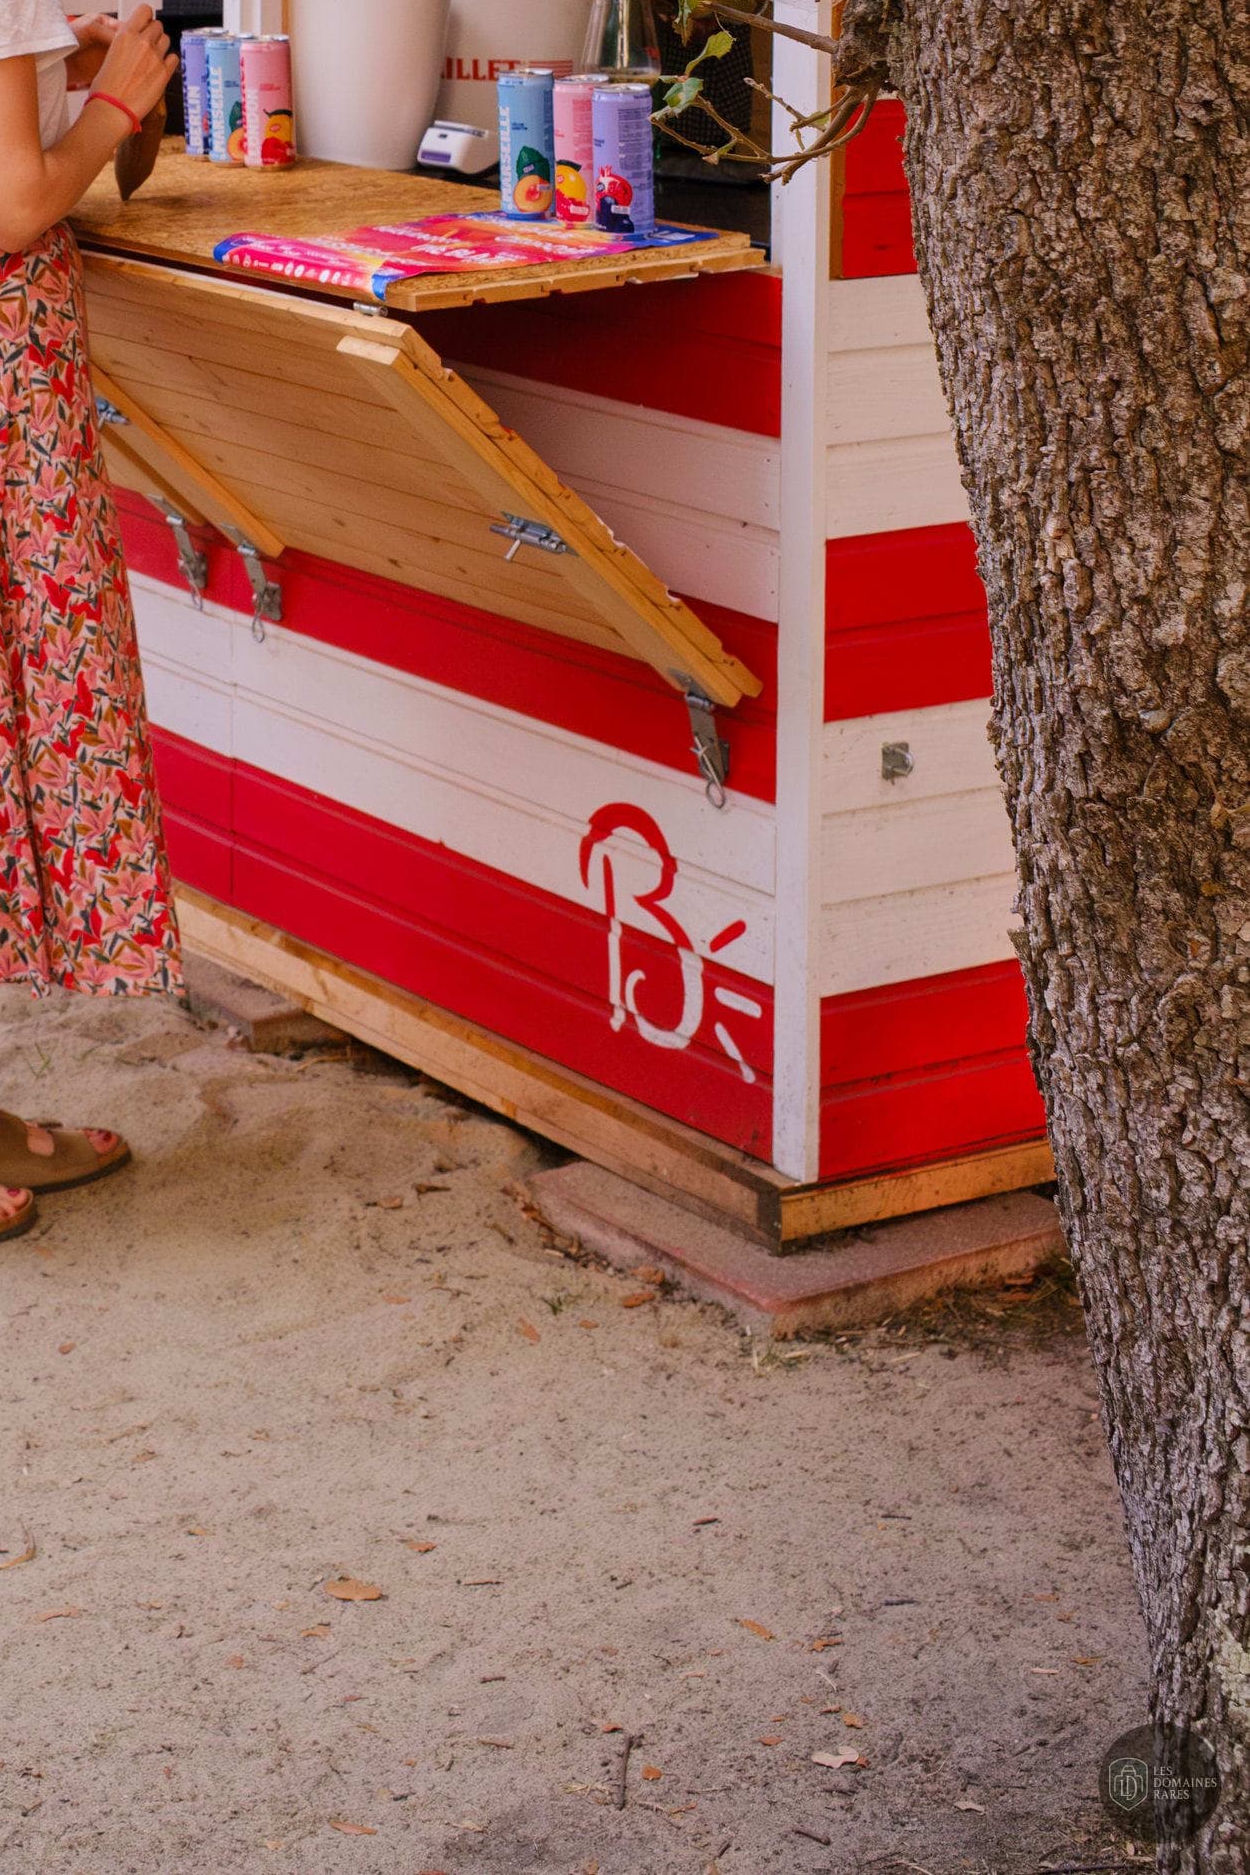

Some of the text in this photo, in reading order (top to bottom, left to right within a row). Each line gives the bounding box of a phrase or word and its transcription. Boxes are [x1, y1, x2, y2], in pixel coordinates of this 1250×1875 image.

[187, 85, 204, 147] BERLIN
[210, 66, 226, 154] MARSEILLE
[246, 88, 262, 165] LONDON
[499, 106, 512, 203] MARSEILLE
